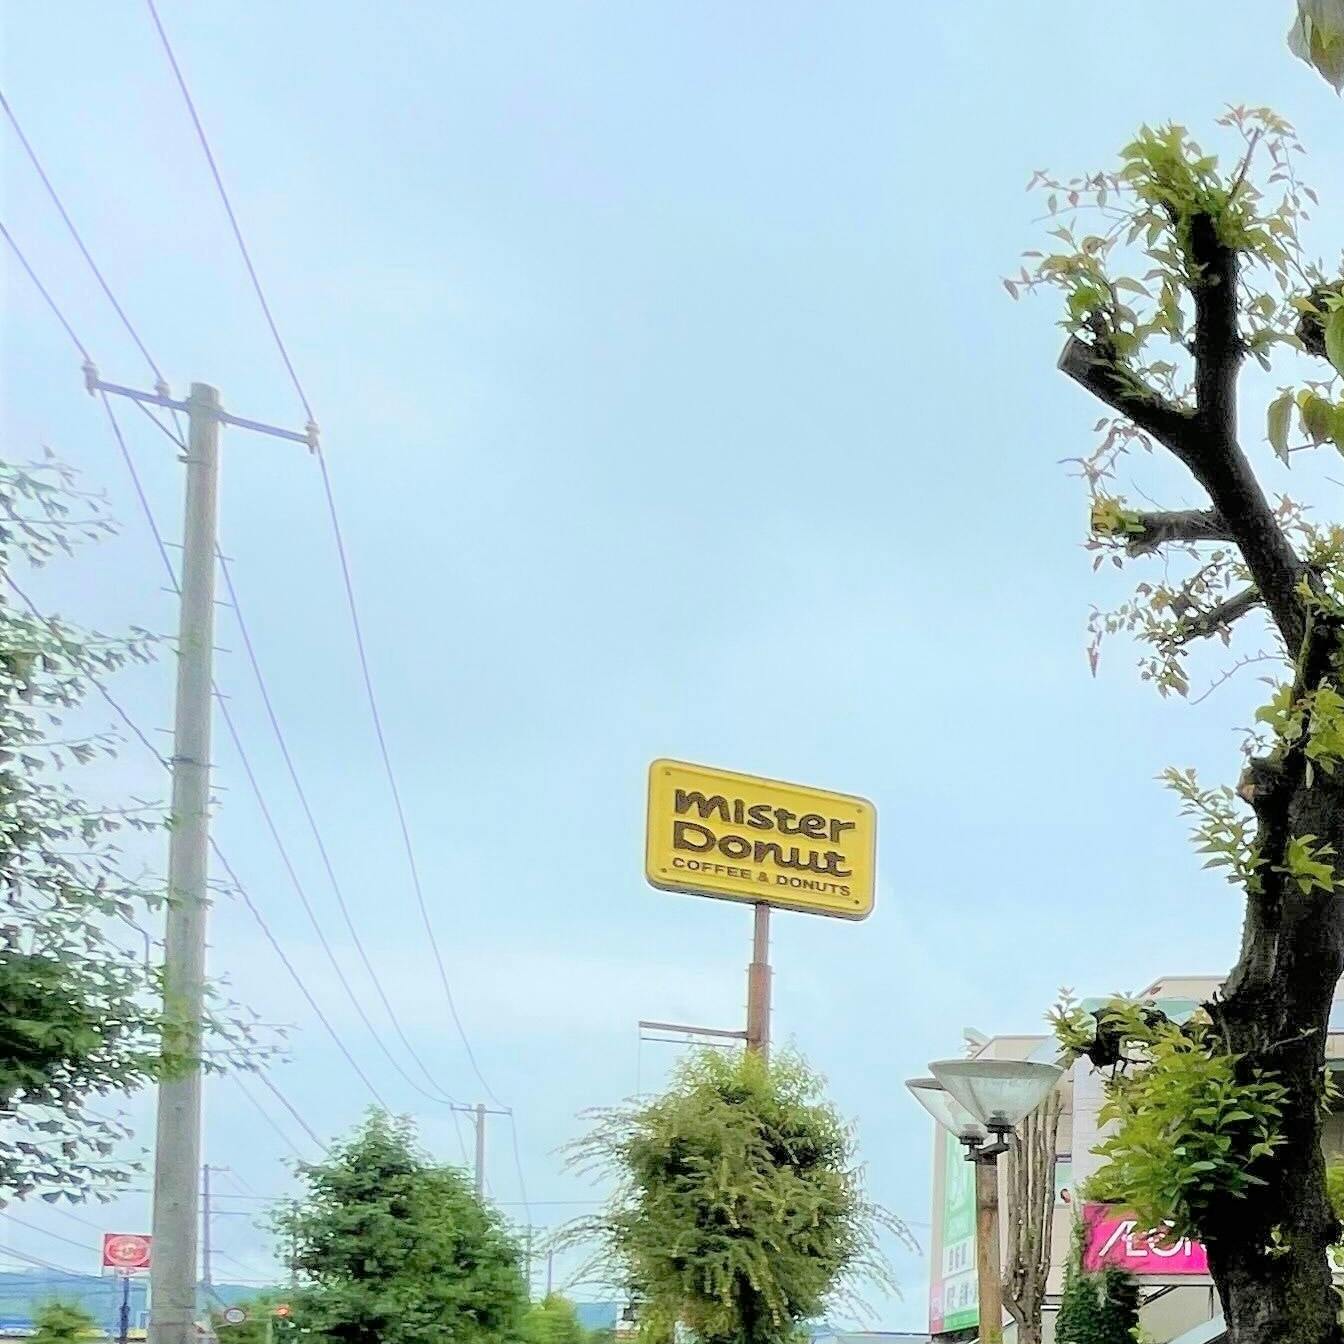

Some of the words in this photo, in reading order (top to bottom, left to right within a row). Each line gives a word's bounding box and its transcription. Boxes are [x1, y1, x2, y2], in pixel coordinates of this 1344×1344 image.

[672, 820, 852, 878] Donut
[672, 857, 752, 881] COFFEE
[756, 872, 770, 883] &
[776, 874, 851, 897] DONUTS
